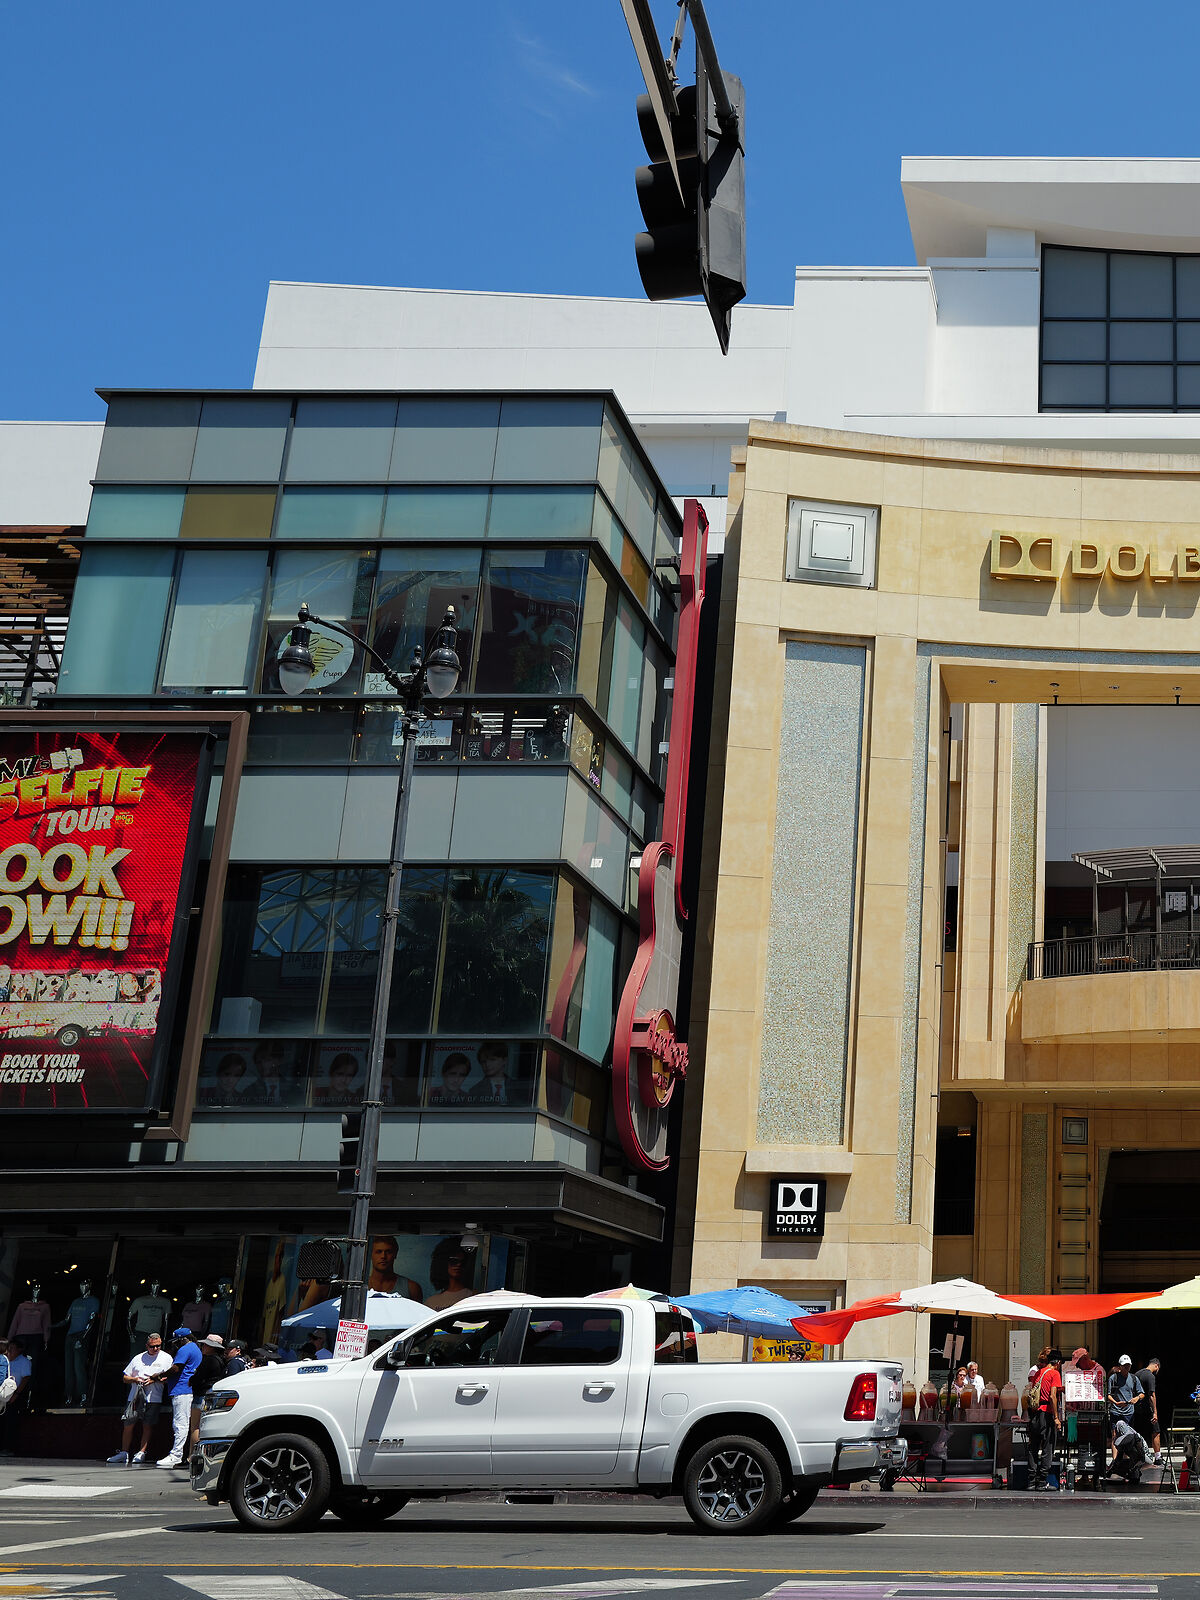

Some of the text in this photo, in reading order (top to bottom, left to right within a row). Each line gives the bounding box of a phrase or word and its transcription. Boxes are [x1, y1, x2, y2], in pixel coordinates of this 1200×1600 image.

[46, 806, 115, 837] TOUR
[1, 1054, 81, 1069] BOOK YOUR
[46, 1068, 86, 1084] NOW!
[776, 1214, 817, 1225] DOLBY
[342, 1322, 366, 1330] TOW-AWAY
[339, 1331, 367, 1344] NO STOPPING
[338, 1344, 362, 1354] ANYTIME
